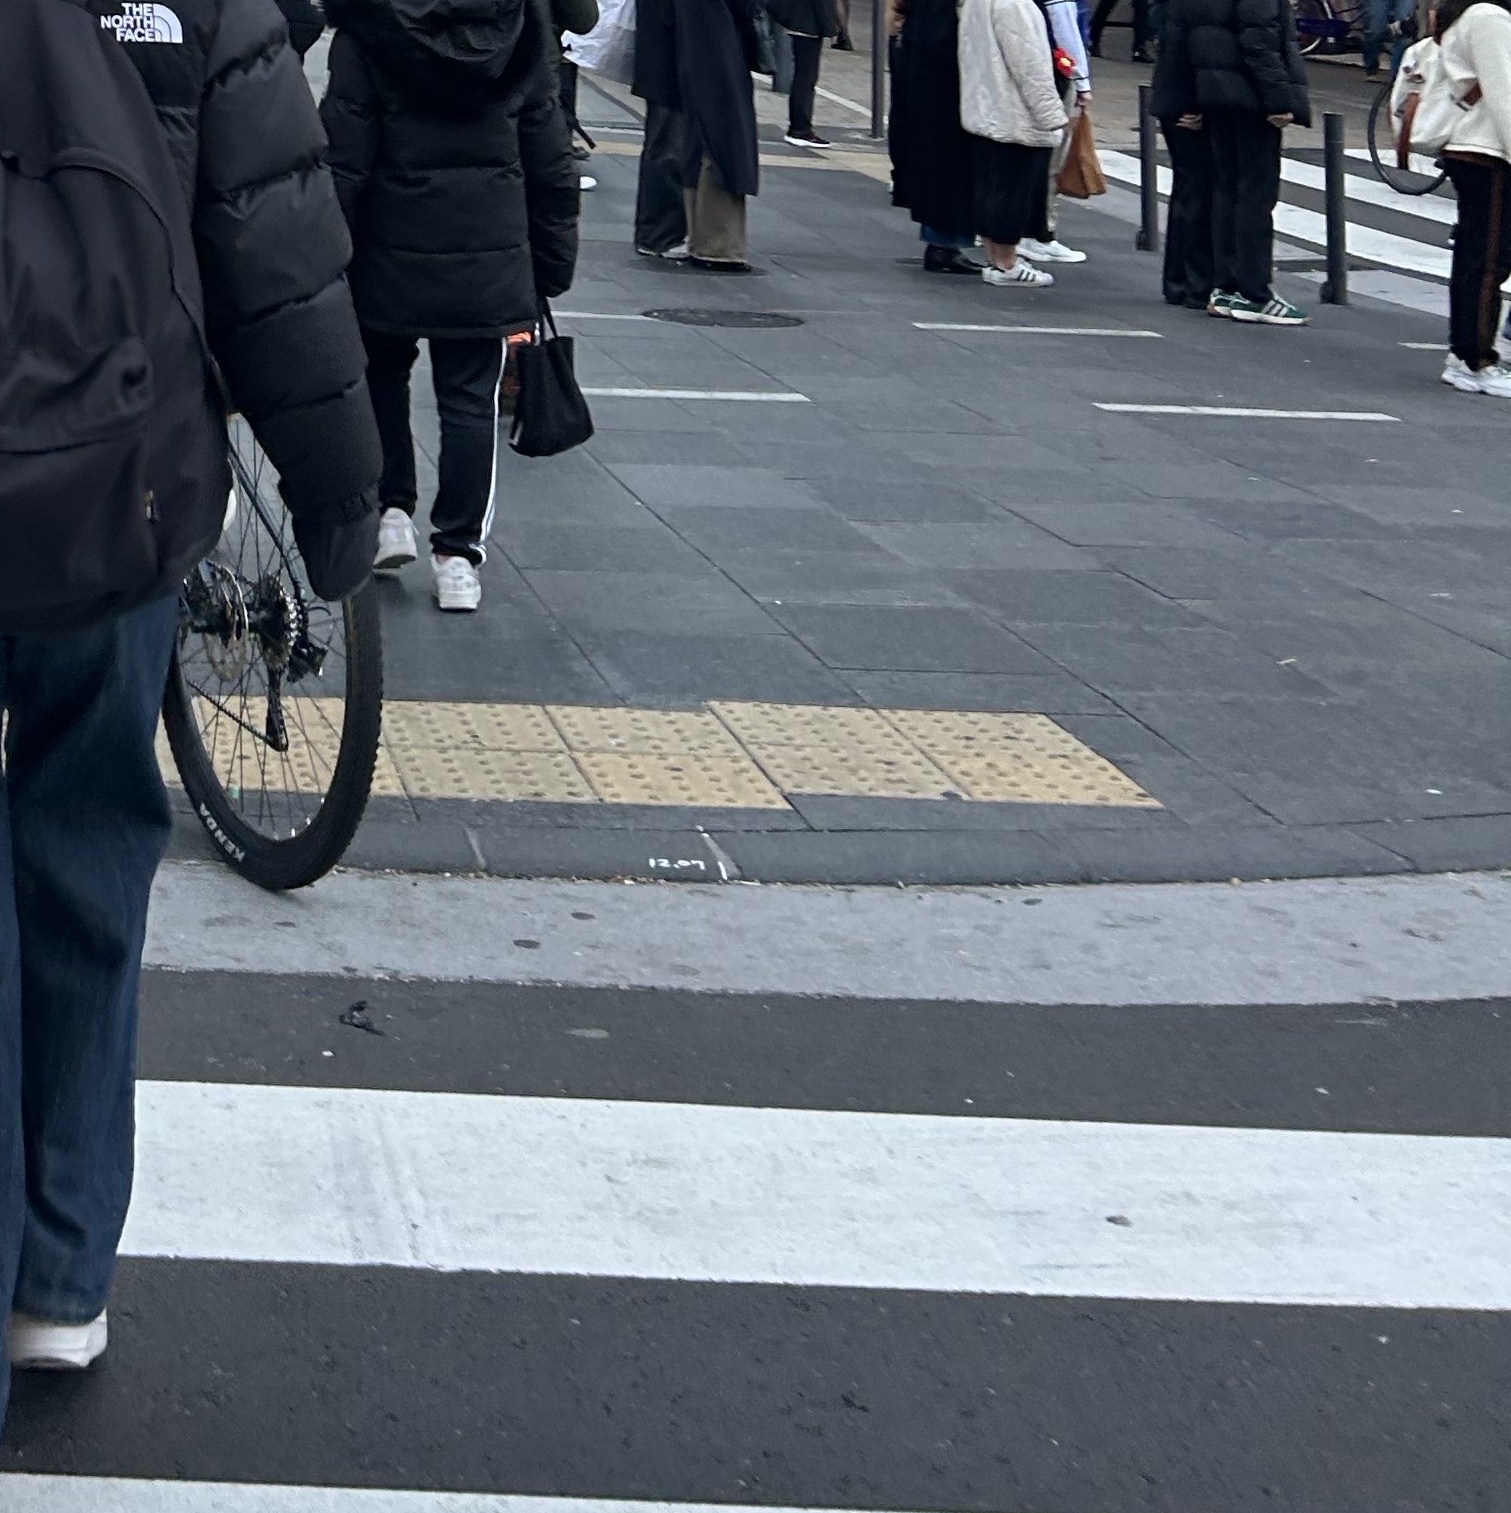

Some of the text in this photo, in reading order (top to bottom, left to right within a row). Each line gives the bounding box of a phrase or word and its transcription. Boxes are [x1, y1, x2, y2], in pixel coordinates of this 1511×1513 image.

[121, 3, 153, 16] THE
[100, 15, 153, 28] NORTH
[116, 28, 155, 42] FACE
[199, 802, 246, 862] KENDA
